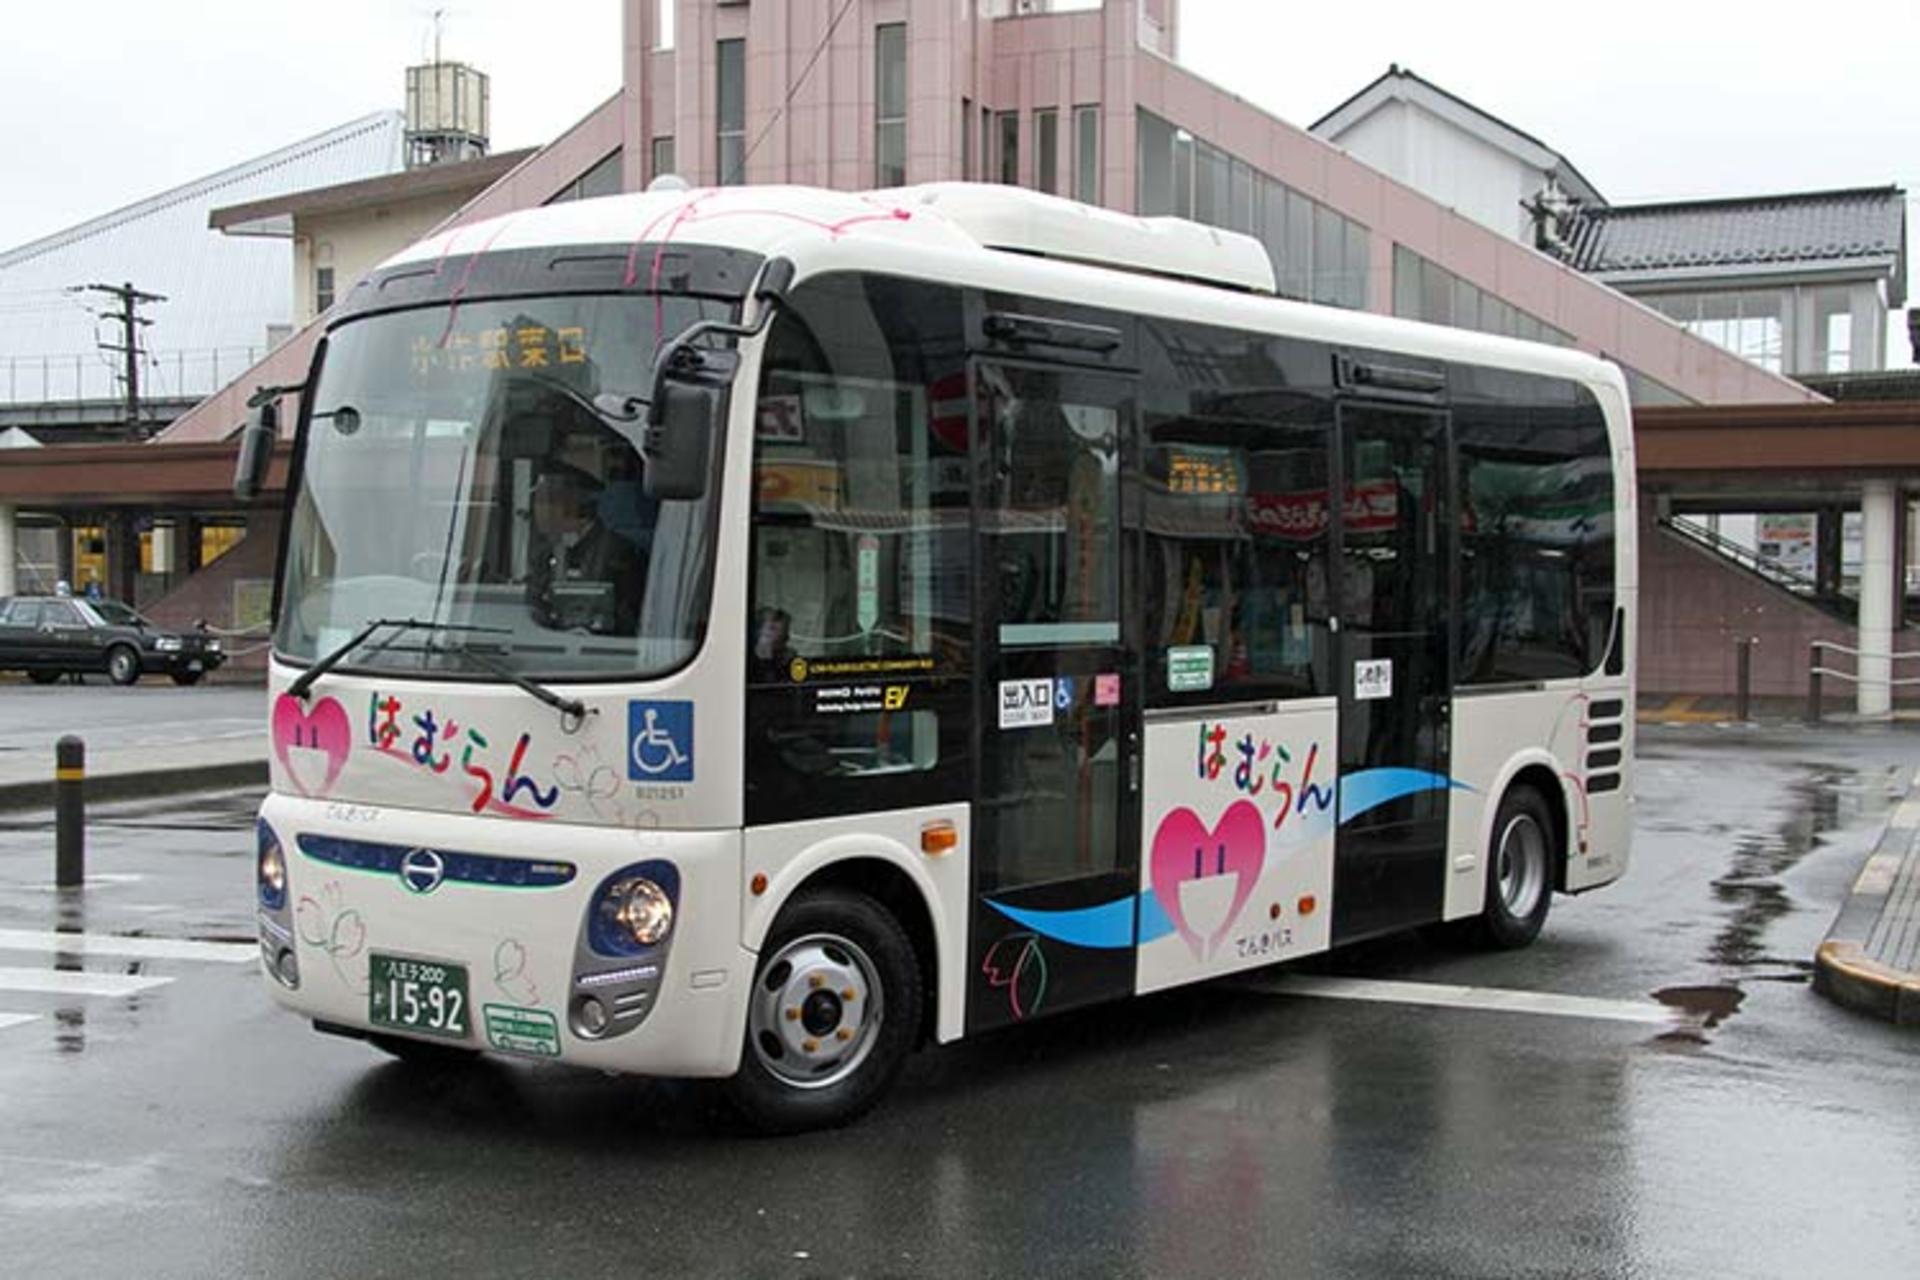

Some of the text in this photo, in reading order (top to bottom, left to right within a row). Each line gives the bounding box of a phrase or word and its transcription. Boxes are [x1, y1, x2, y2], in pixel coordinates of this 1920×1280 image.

[885, 684, 910, 710] EV
[1003, 684, 1050, 709] 出入口
[369, 690, 559, 813] はむらん
[1198, 722, 1333, 830] はむらん
